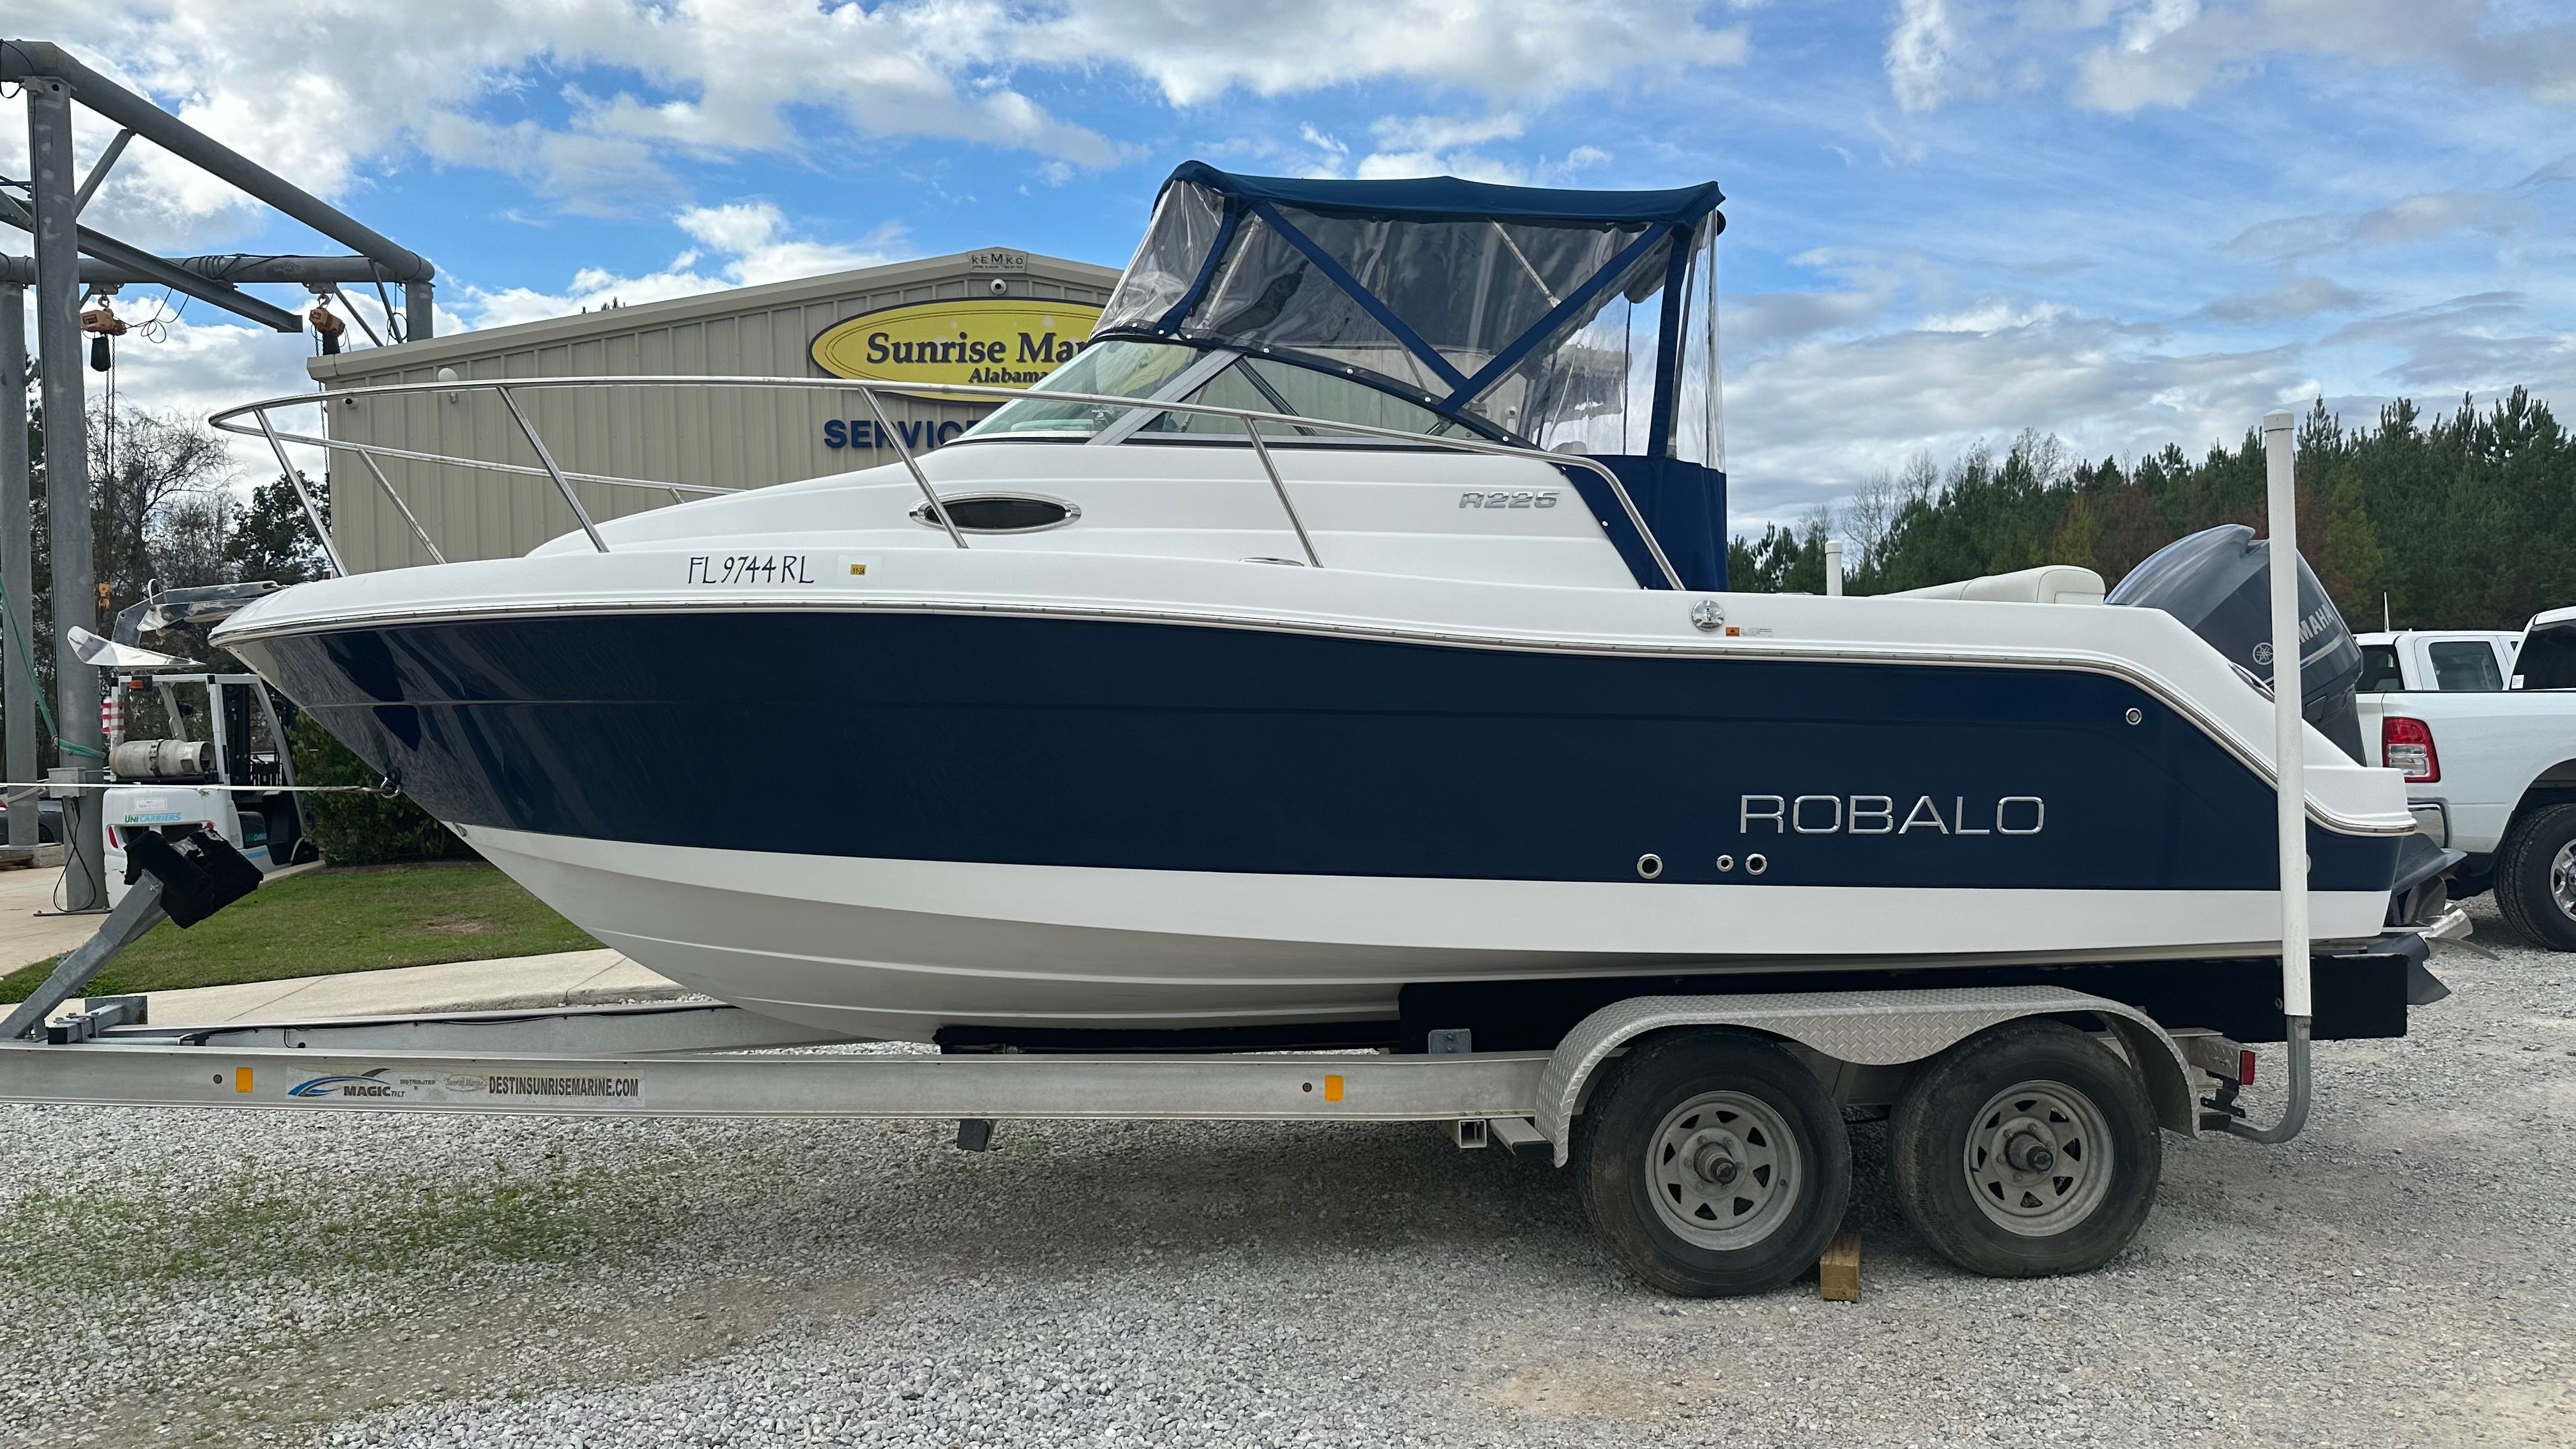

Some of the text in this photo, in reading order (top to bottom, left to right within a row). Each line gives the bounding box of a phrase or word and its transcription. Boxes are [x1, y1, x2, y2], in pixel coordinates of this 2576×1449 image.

[972, 253, 1023, 264] KEMKO
[866, 332, 1006, 364] Sunrise
[1459, 491, 1560, 509] R225
[688, 555, 815, 584] FL 9744 RL
[1739, 795, 2044, 835] ROBALO
[344, 1086, 390, 1096] MAGIC
[489, 1076, 638, 1097] DESTINSUNRISEMARINE.COM
